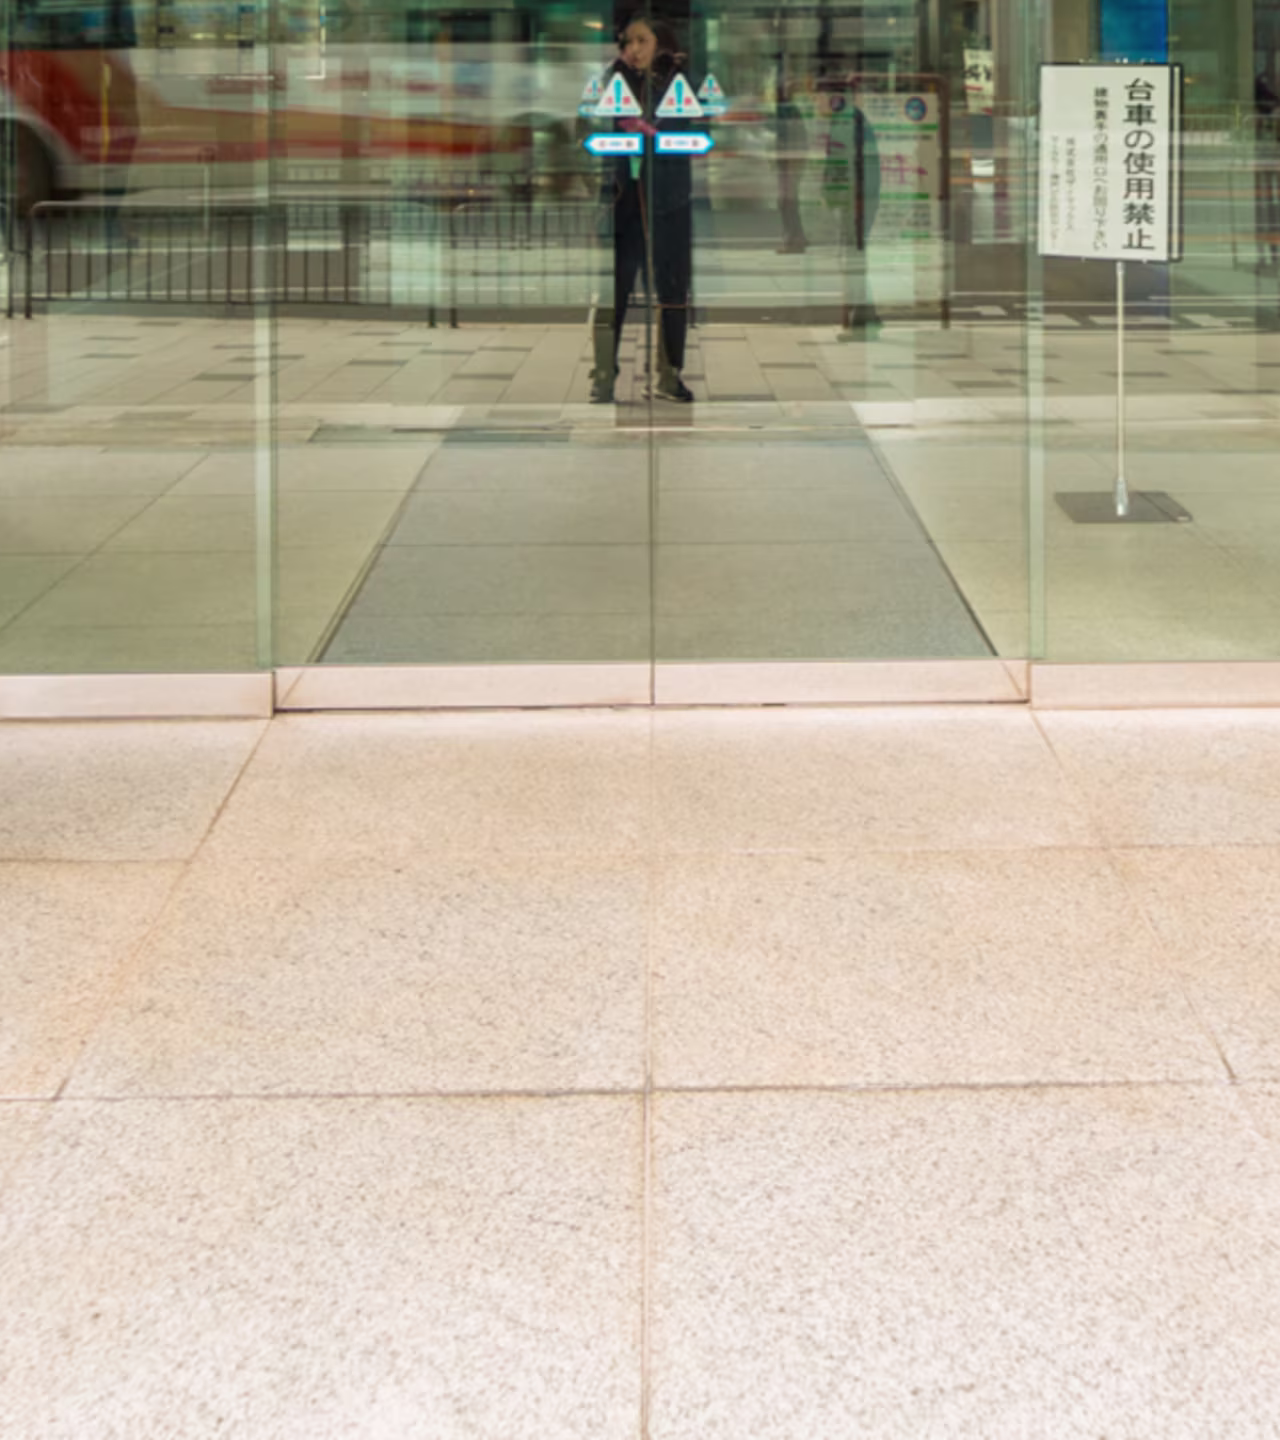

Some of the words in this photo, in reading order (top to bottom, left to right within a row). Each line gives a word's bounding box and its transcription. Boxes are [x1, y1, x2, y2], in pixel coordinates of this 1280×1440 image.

[1122, 77, 1157, 251] 台車の使用禁止
